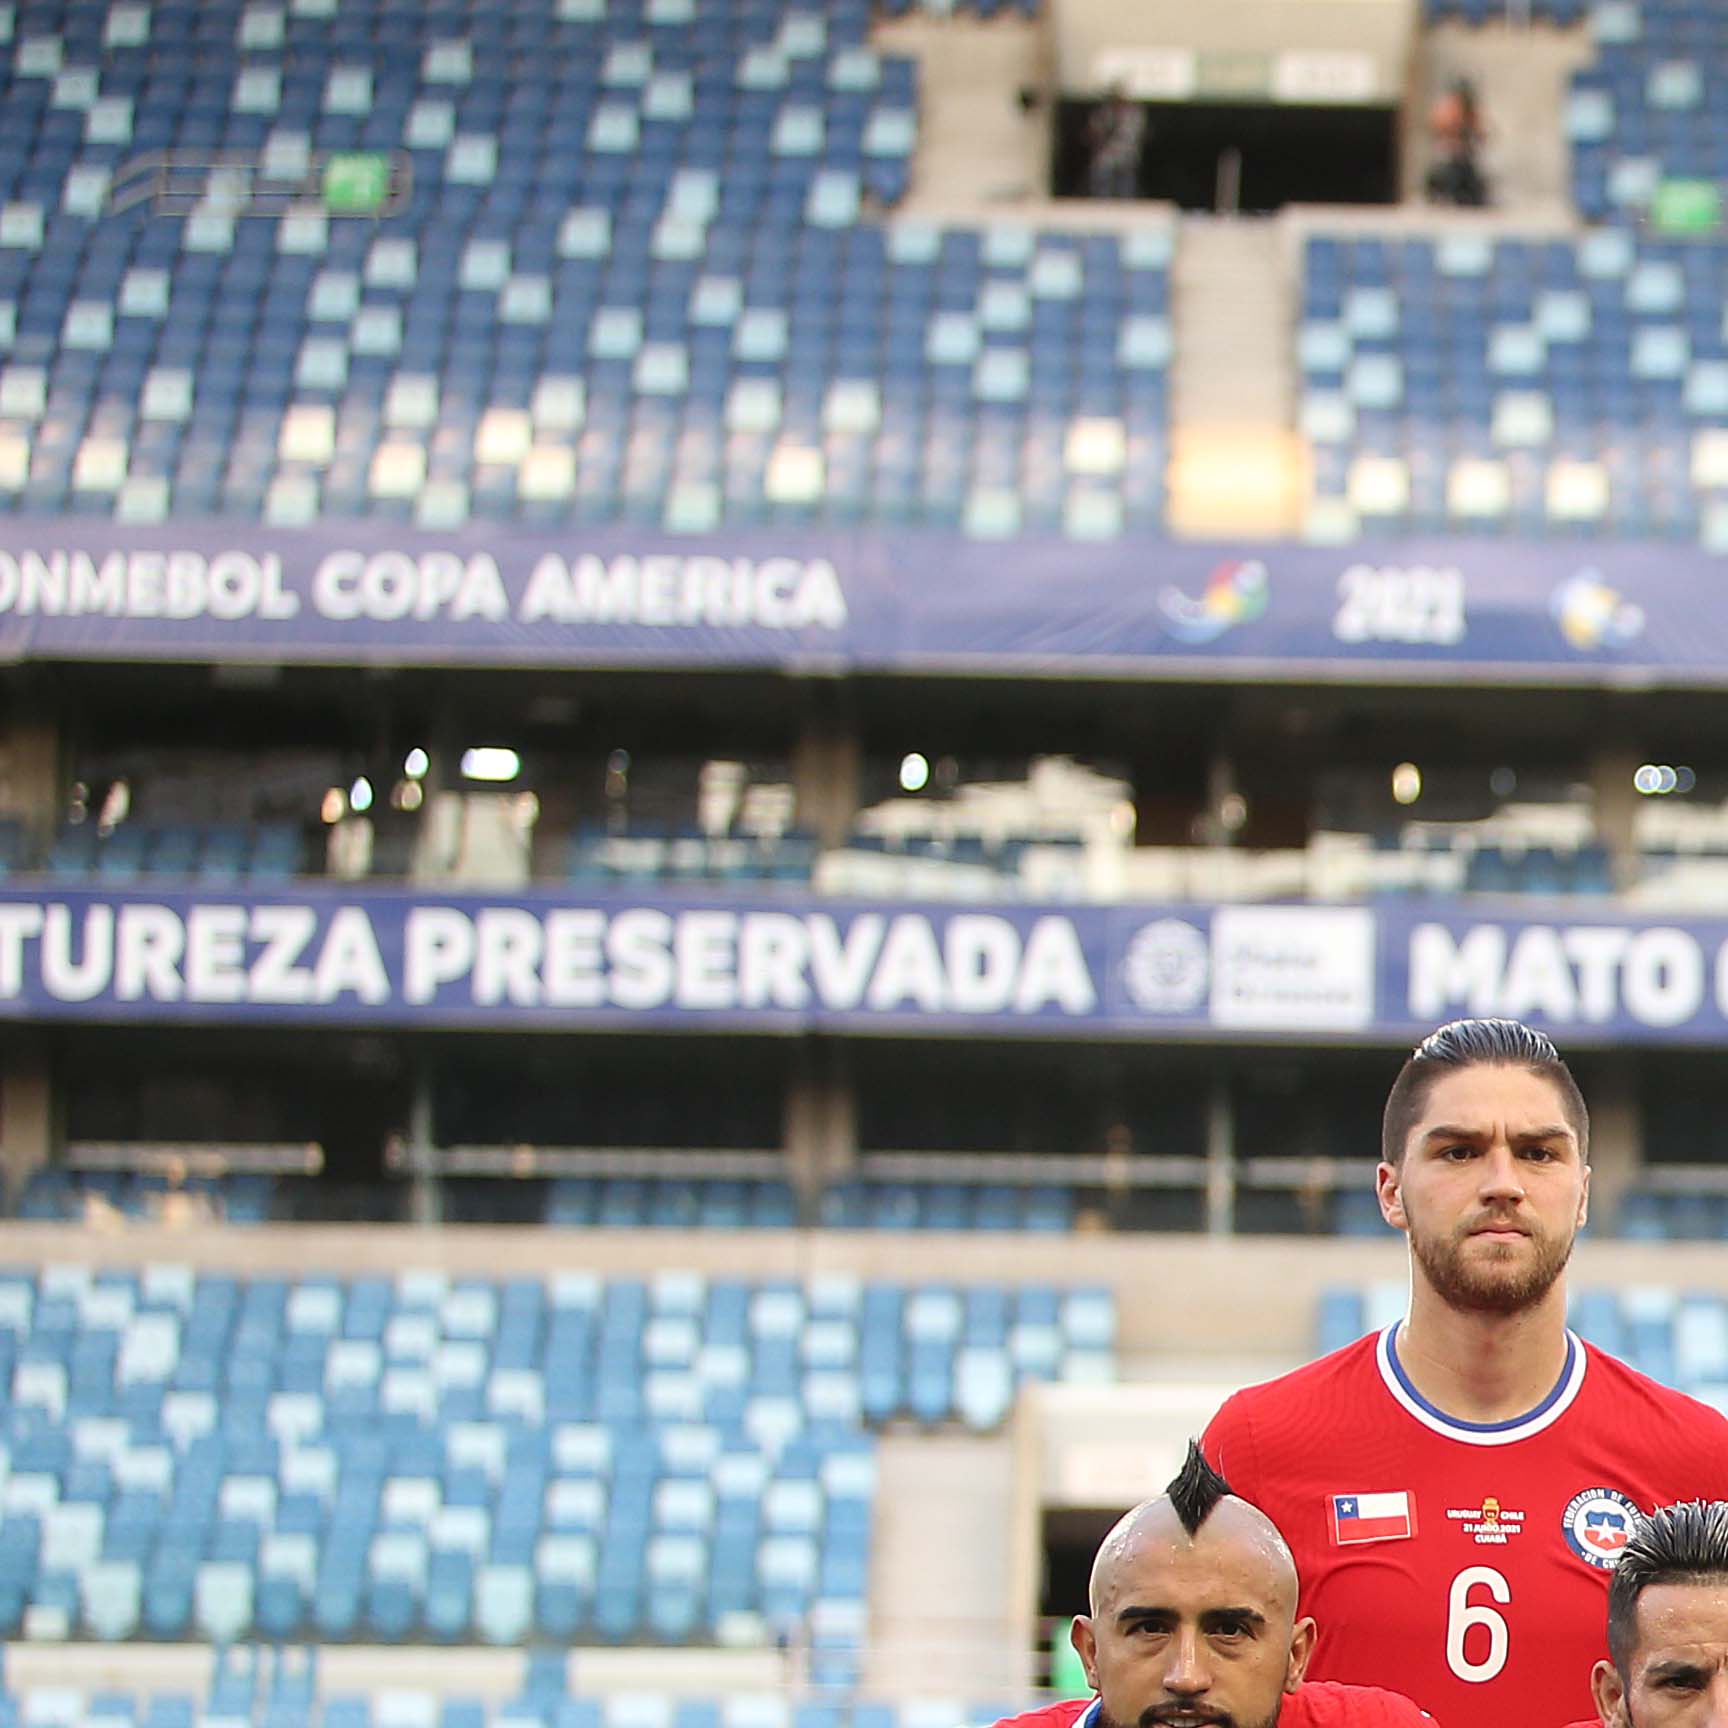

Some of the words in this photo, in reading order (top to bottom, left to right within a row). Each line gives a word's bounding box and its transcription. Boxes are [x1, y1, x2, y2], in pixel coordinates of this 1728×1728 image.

[313, 551, 508, 623] COPA
[520, 555, 848, 632] AMERICA
[1332, 565, 1467, 646] 2021
[0, 902, 391, 1005] TUREZA
[406, 908, 1095, 1017] PRESERVADA
[1408, 923, 1705, 1028] MATO
[1445, 1566, 1511, 1683] 6
